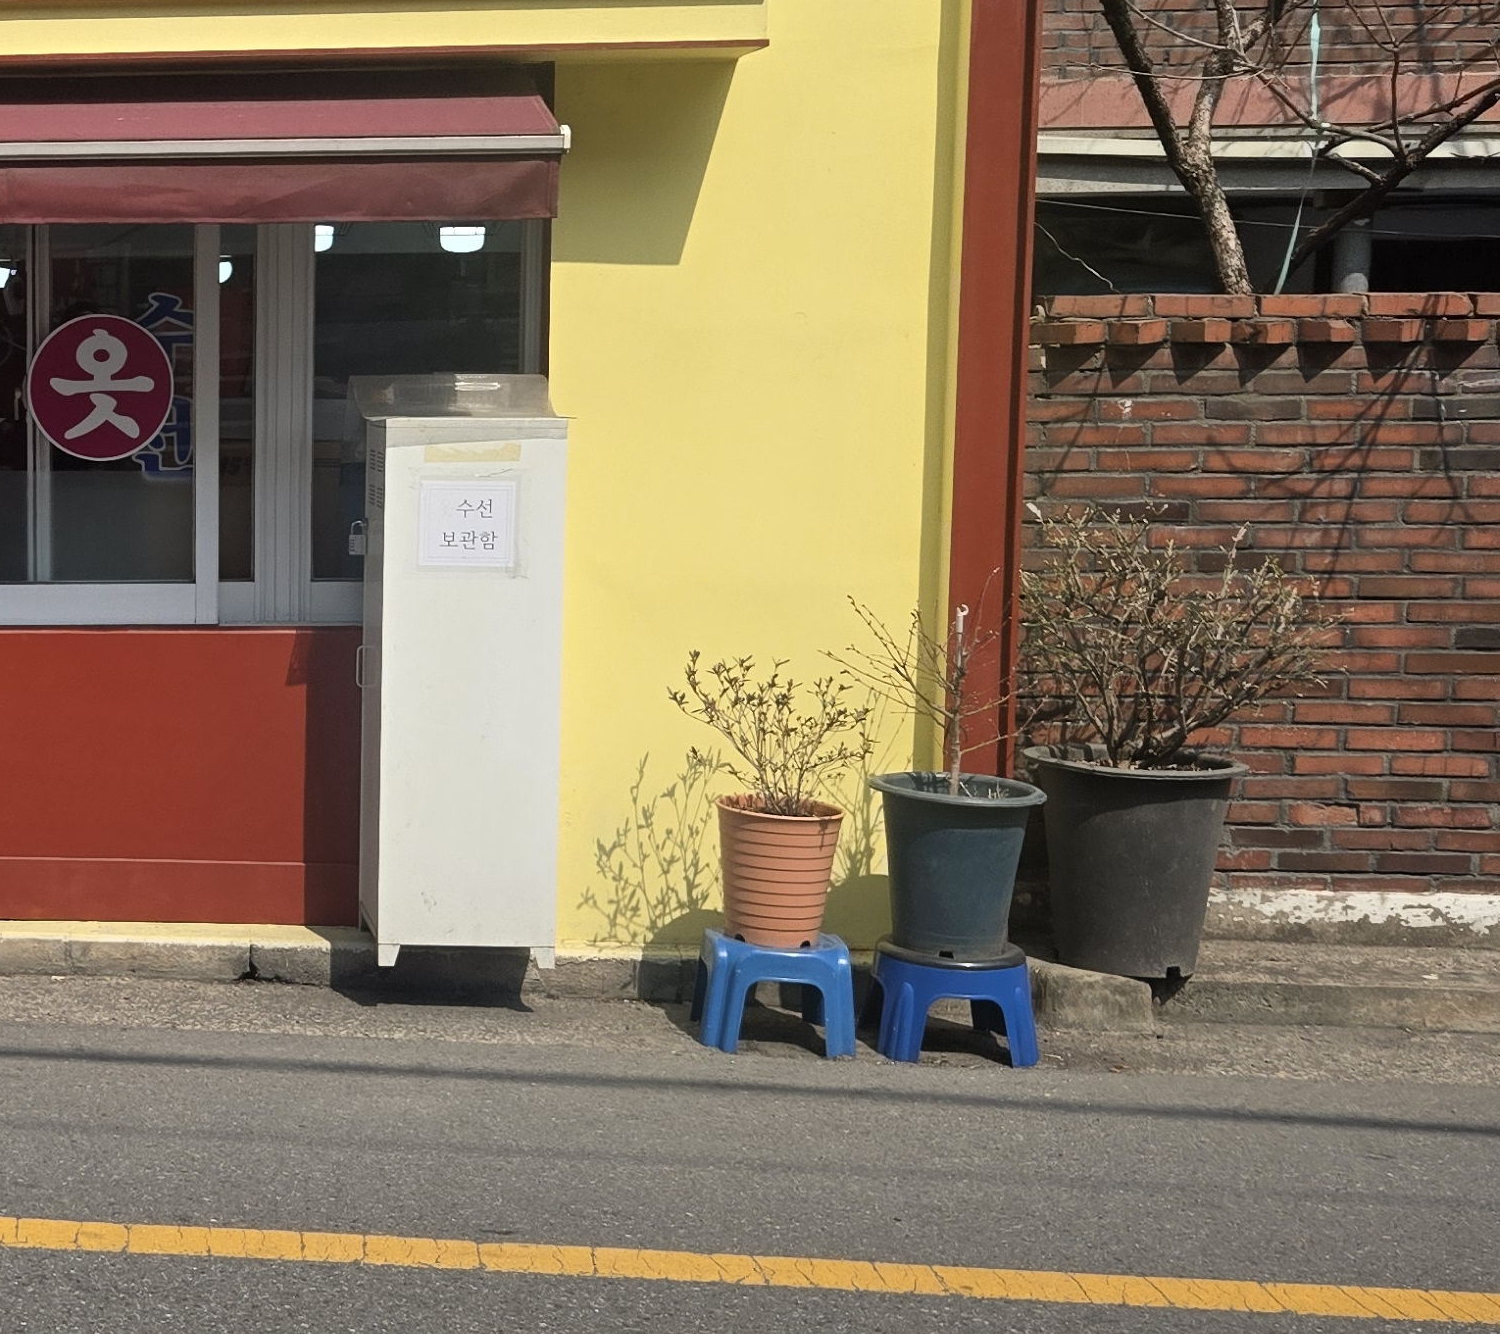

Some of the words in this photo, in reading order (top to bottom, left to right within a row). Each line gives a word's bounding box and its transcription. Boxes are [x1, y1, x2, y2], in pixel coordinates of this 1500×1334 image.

[50, 329, 154, 440] 옷
[456, 498, 493, 518] 수선
[439, 530, 498, 550] 보관함
